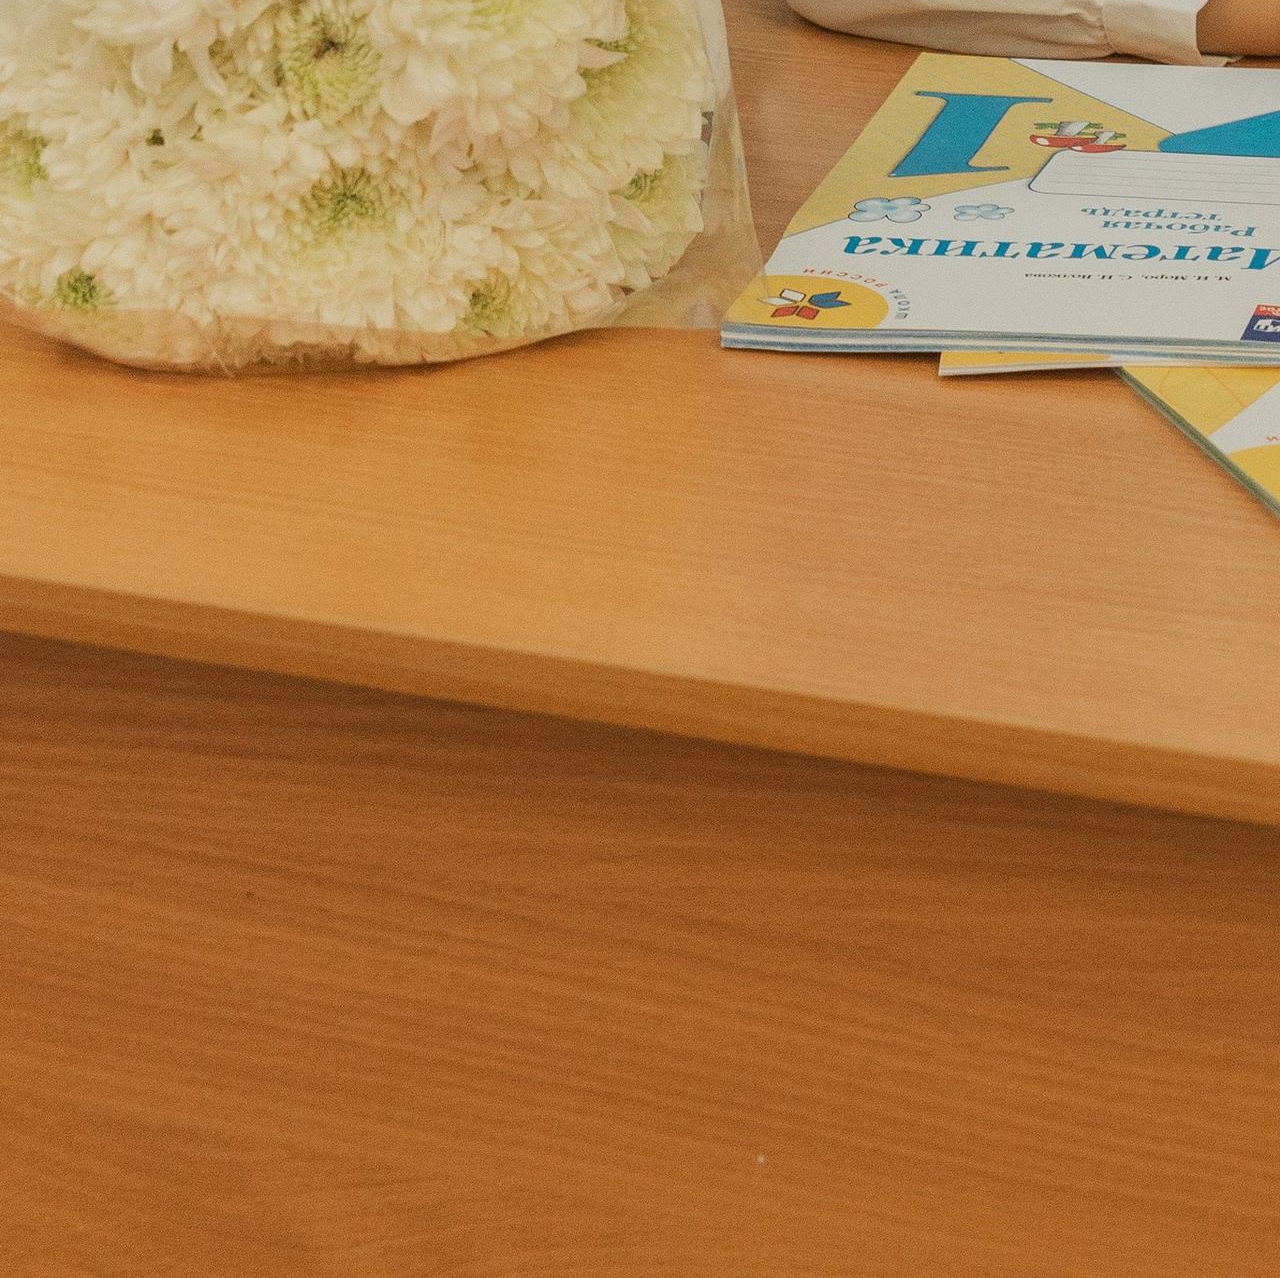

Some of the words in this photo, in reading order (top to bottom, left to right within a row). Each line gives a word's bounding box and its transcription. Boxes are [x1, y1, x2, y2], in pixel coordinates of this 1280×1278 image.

[1080, 207, 1223, 222] тетрадь
[1101, 219, 1258, 238] Рабочая
[801, 267, 889, 289] РОССИИ
